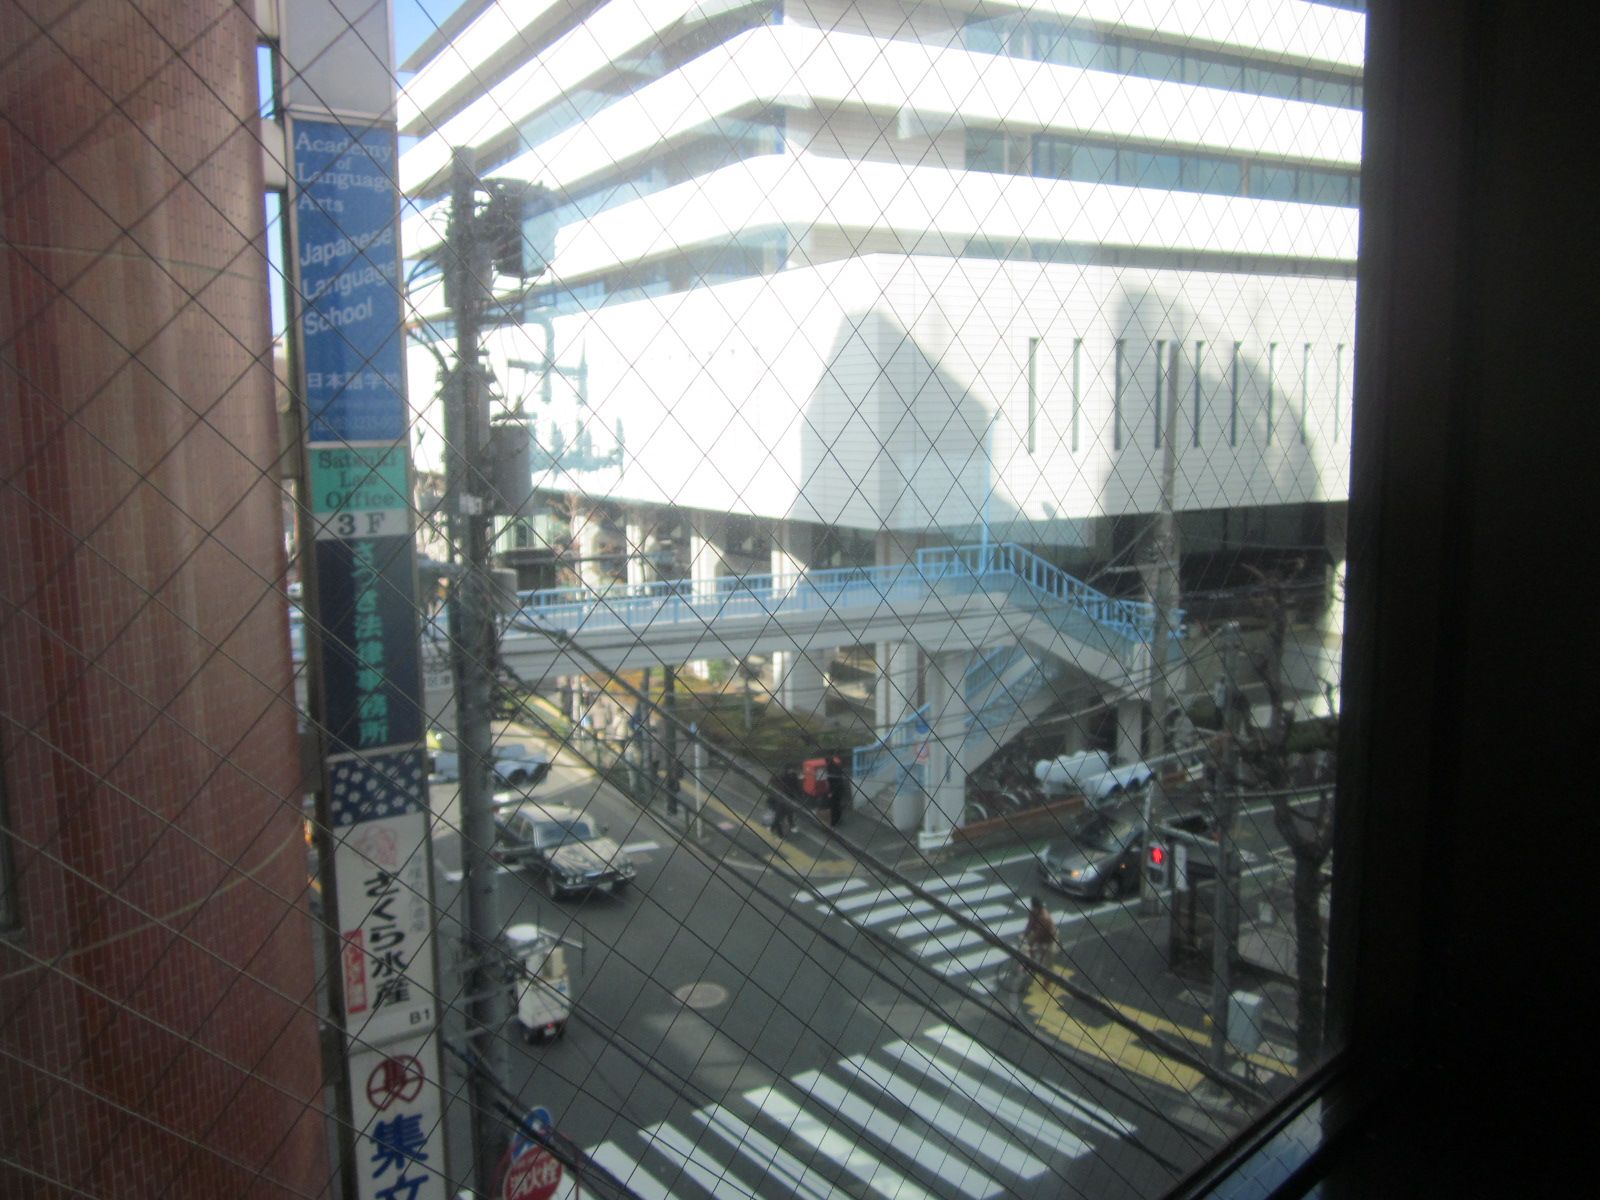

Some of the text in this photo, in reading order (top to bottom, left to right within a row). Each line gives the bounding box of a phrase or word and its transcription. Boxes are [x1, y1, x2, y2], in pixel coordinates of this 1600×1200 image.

[295, 130, 393, 162] Academy
[337, 156, 351, 171] of
[298, 194, 344, 213] Arts
[300, 226, 393, 266] Japanese
[302, 260, 397, 300] Language
[304, 297, 373, 335] School
[364, 870, 411, 1010] さくら水産
[410, 1009, 431, 1025] B1
